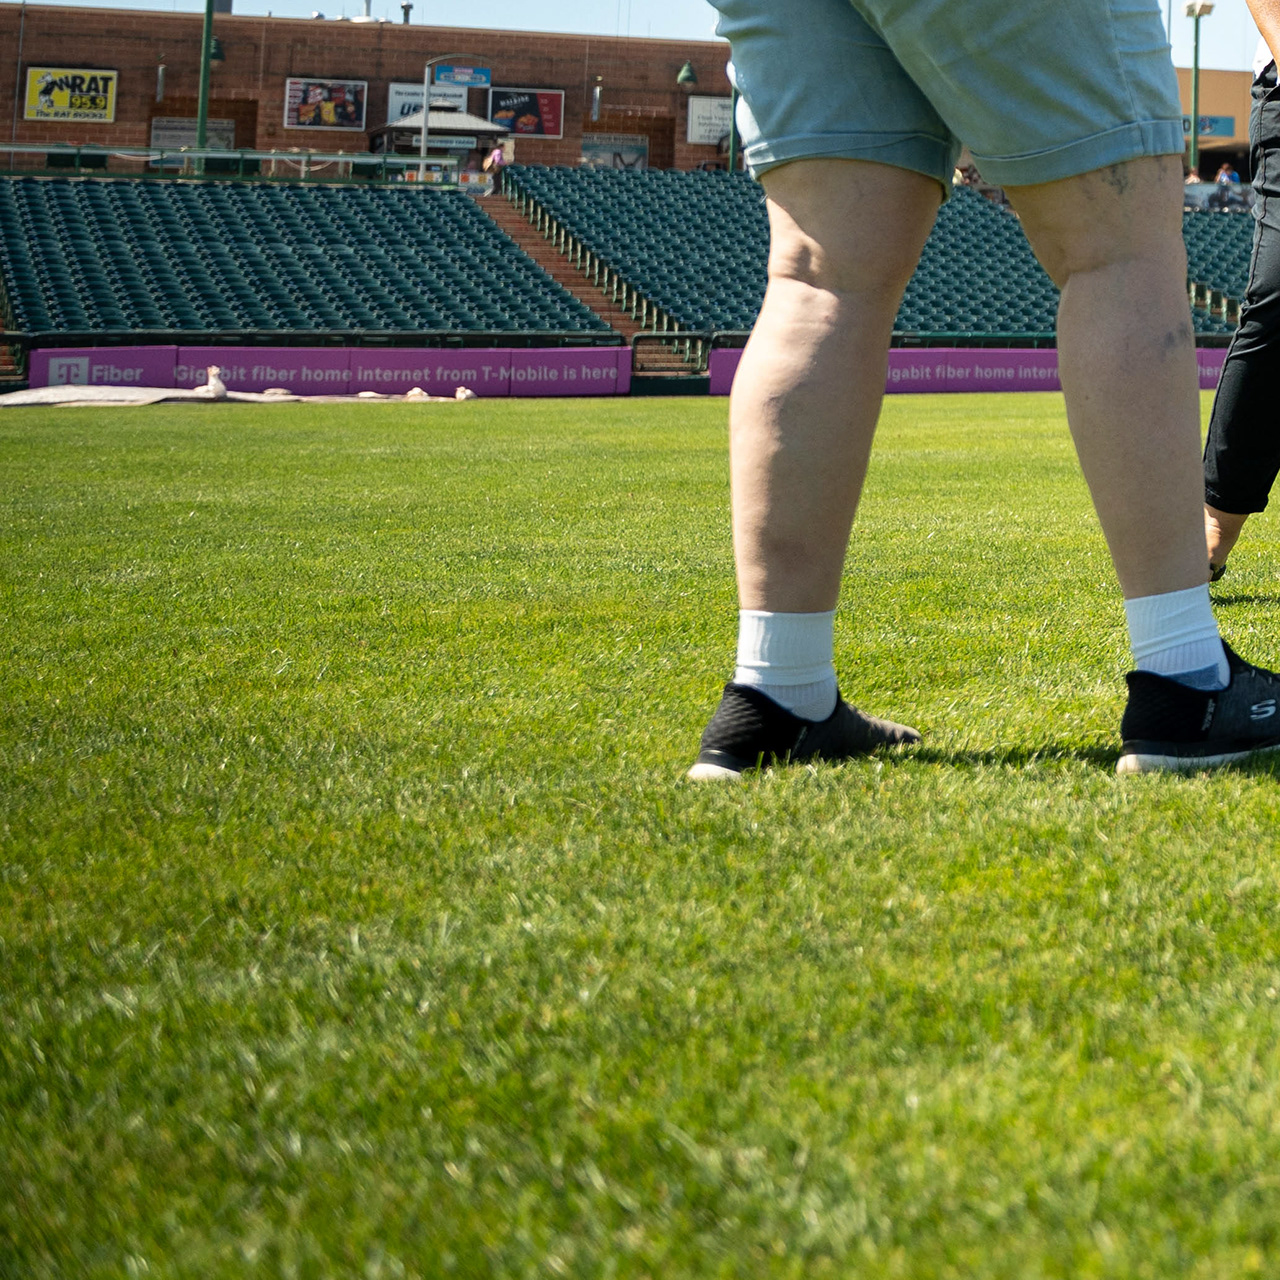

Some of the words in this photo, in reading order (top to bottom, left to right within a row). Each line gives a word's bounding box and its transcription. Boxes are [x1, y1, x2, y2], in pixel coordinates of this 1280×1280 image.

[70, 96, 106, 110] 95.9
[92, 365, 143, 382] Fiber
[174, 366, 246, 385] Gigbit
[251, 365, 297, 382] fiber
[301, 366, 351, 382] home
[358, 366, 431, 382] internet
[436, 365, 477, 381] from
[482, 365, 558, 381] T-Mobile
[563, 365, 577, 380] is
[581, 365, 618, 380] here
[887, 365, 932, 383] igabit
[936, 365, 971, 379] fiber
[975, 365, 1015, 380] home
[1019, 365, 1058, 379] inter
